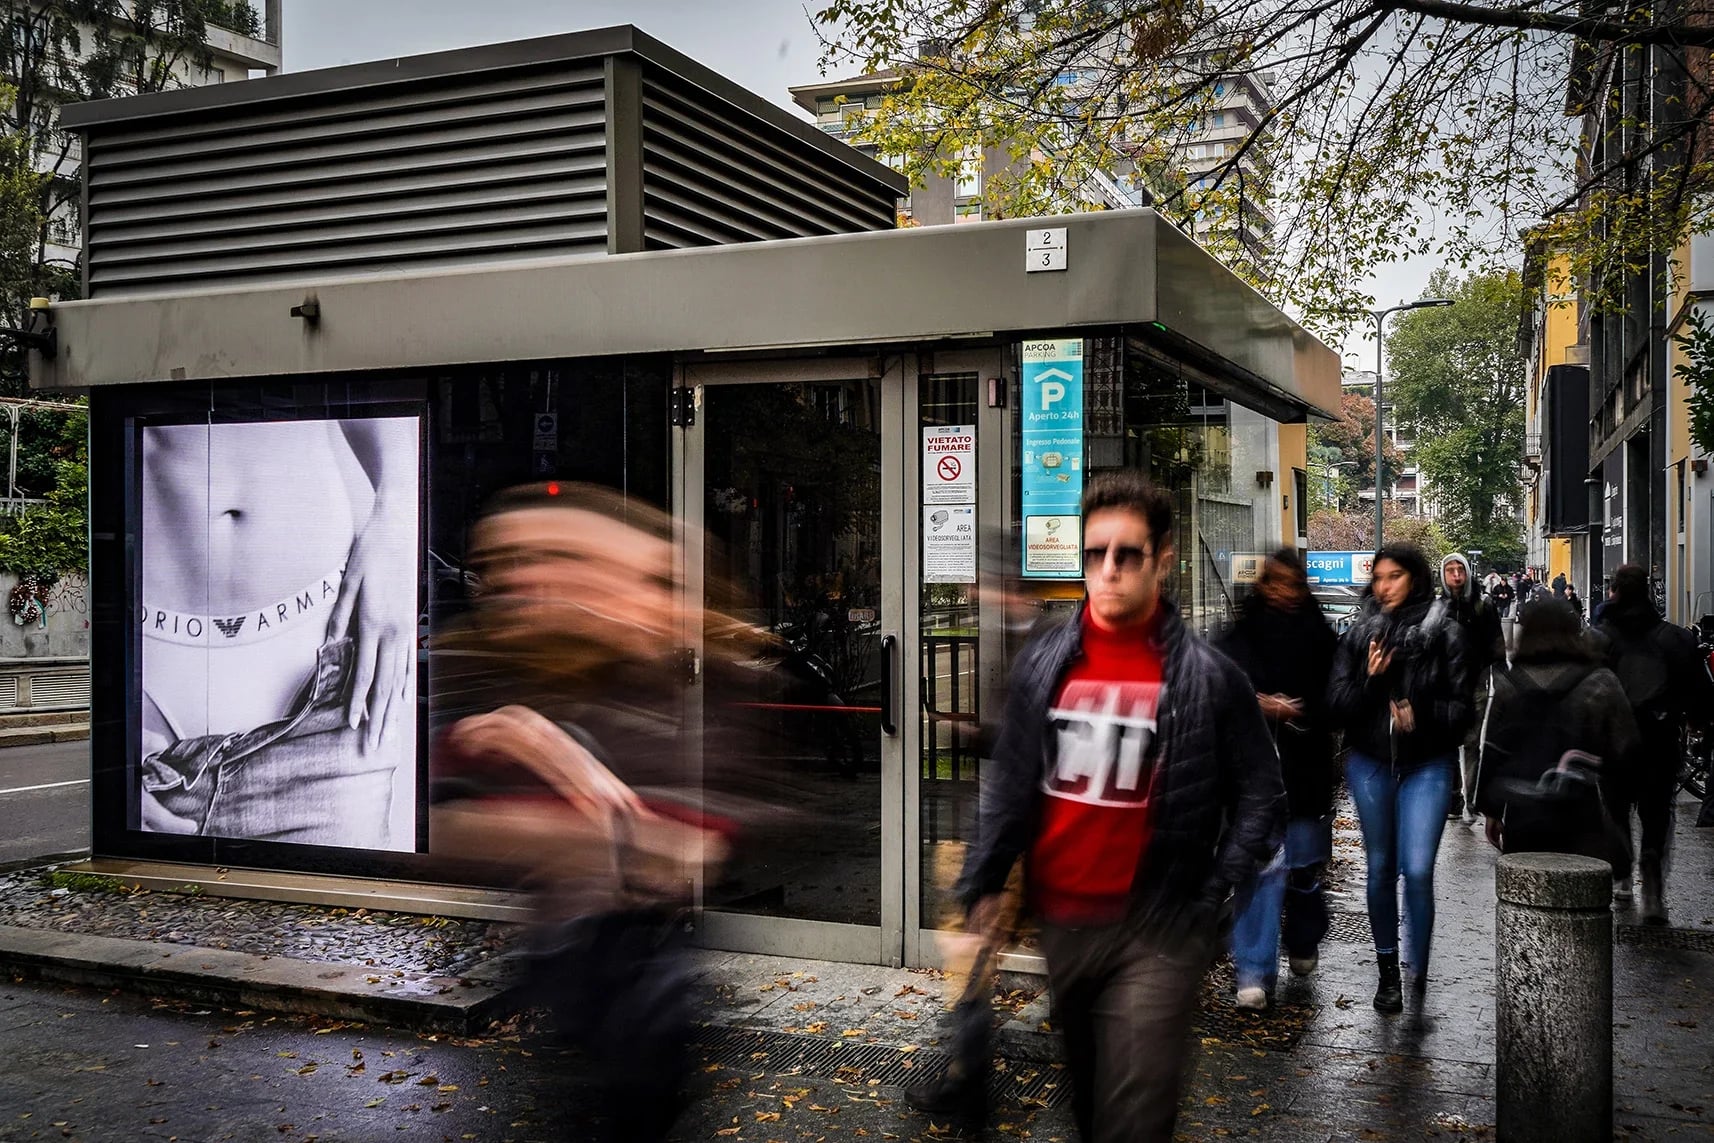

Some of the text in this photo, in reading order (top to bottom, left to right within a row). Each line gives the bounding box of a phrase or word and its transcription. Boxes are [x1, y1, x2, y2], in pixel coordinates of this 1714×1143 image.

[1043, 231, 1051, 244] 2
[1042, 253, 1050, 266] 3
[1024, 343, 1056, 351] APCOA
[1024, 350, 1056, 359] PARKING
[1041, 382, 1065, 411] P
[1028, 410, 1080, 421] Aperto 24h
[957, 524, 972, 532] AREA
[1306, 557, 1344, 571] scagni
[257, 569, 346, 632] ARMA
